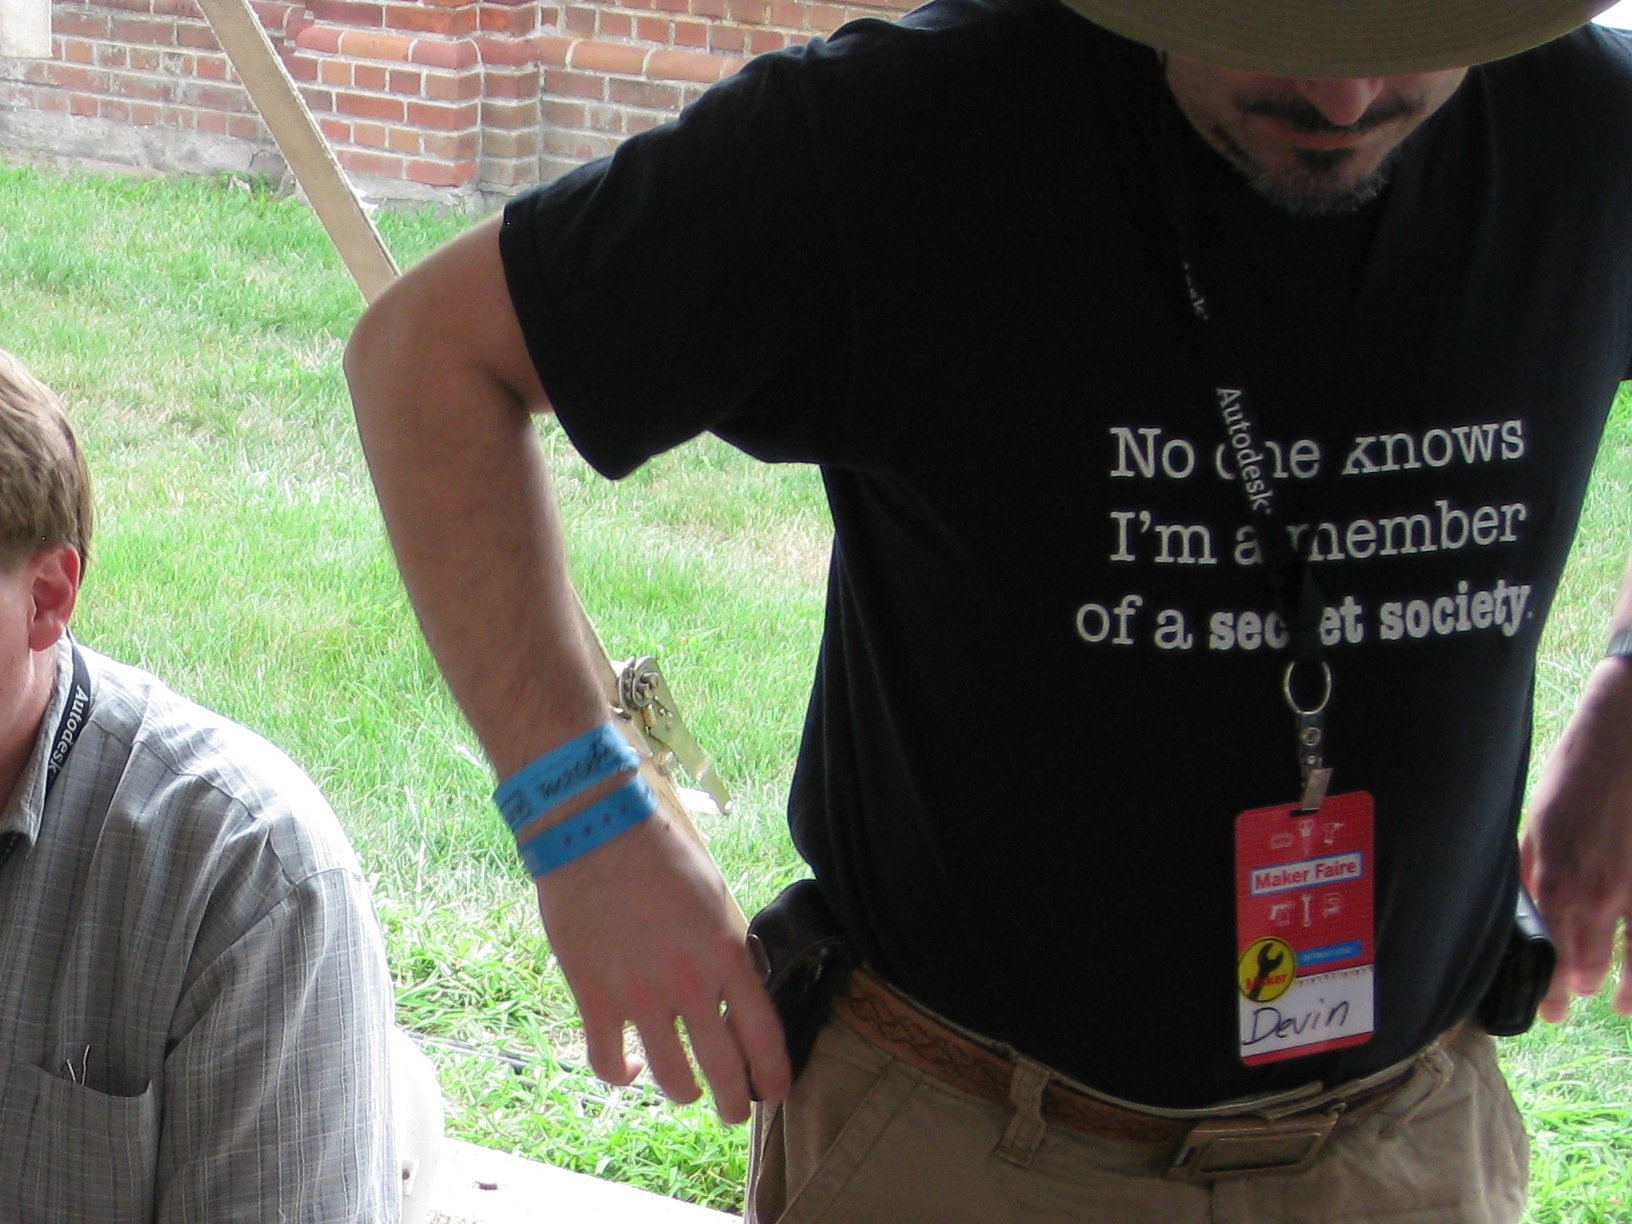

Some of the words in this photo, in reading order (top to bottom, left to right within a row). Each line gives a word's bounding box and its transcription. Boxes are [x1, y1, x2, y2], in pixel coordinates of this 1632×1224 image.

[1109, 426, 1196, 479] No
[1341, 418, 1526, 475] knows
[1216, 387, 1274, 511] Autodesk
[1109, 510, 1218, 565] I'm
[1234, 524, 1264, 566] a
[1075, 593, 1144, 646] of
[1154, 608, 1194, 650] a
[1208, 595, 1365, 651] secet
[48, 685, 89, 773] Autodesk
[1253, 869, 1311, 891] Maker
[1314, 859, 1359, 881] Faire
[1242, 998, 1350, 1046] Devin
